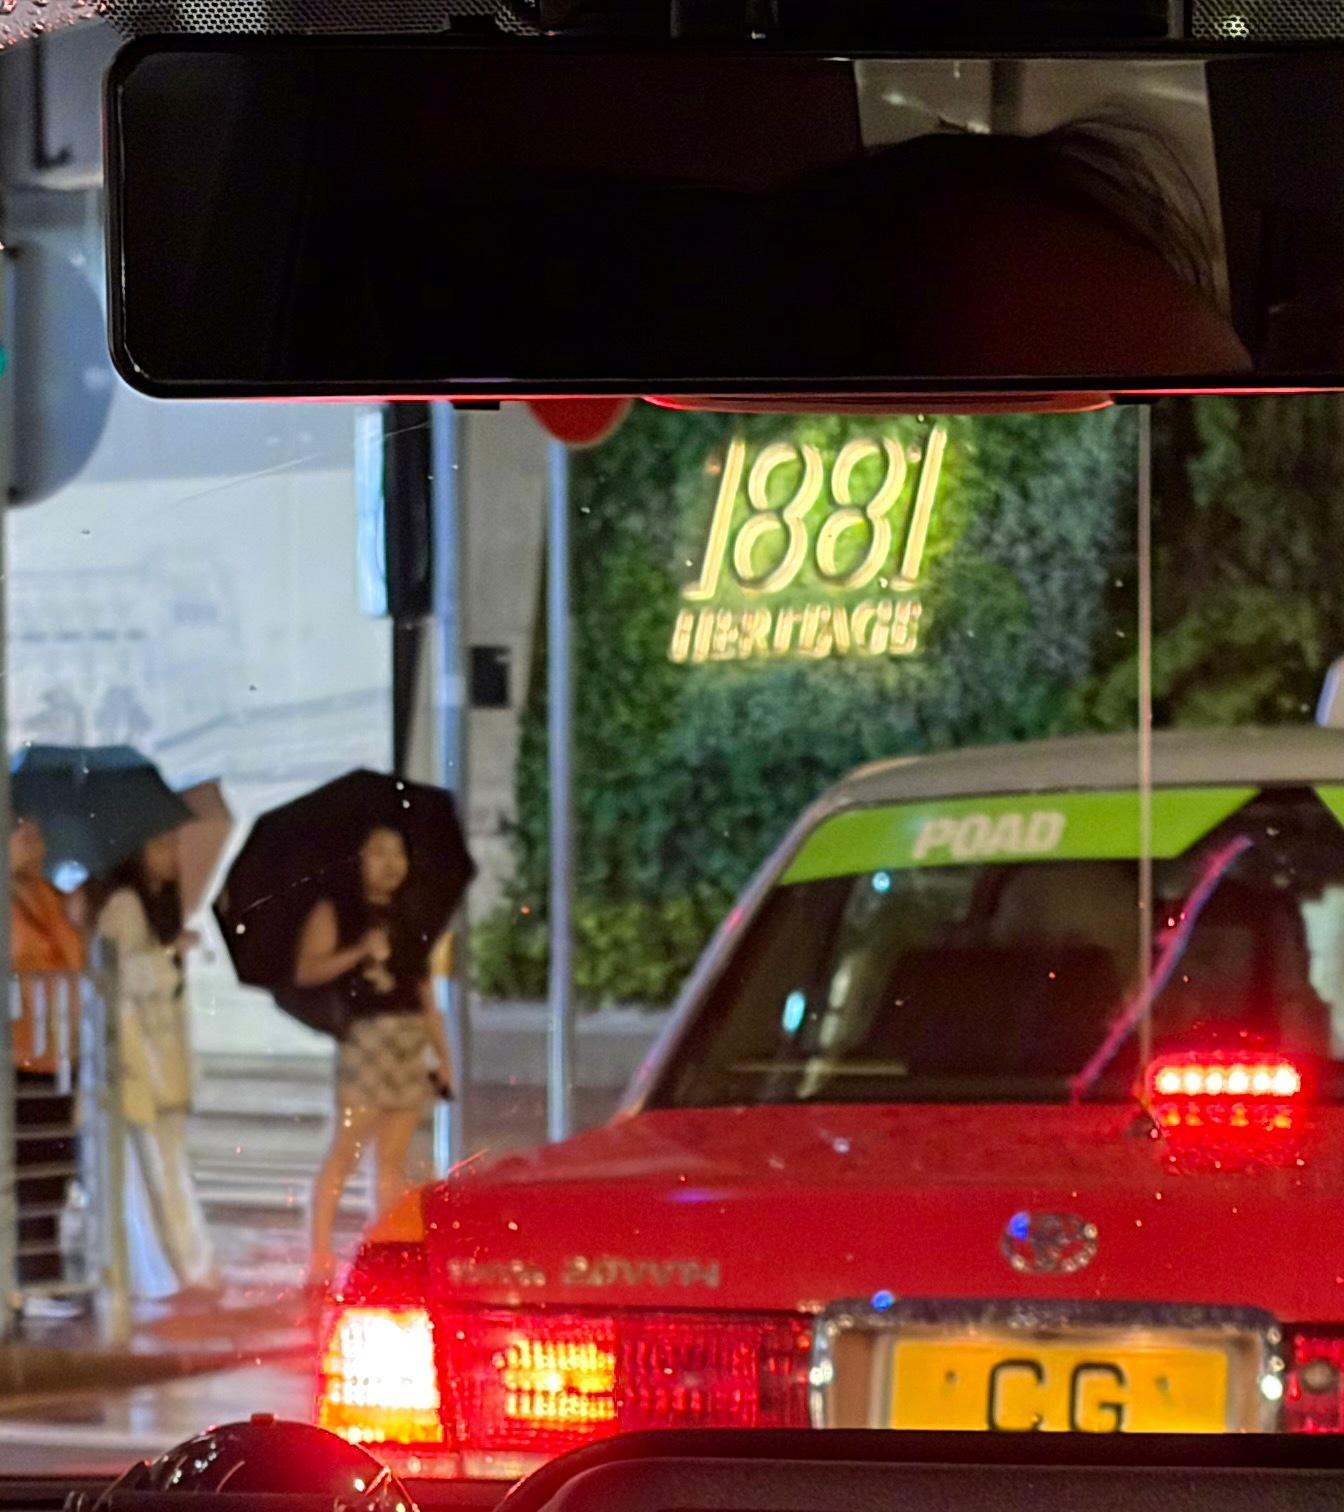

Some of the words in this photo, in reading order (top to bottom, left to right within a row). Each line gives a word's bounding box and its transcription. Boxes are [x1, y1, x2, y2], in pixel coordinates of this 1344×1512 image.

[682, 425, 946, 600] 1881
[668, 601, 922, 663] HERITAGE
[912, 810, 1067, 860] POAD
[987, 1358, 1126, 1433] CG
